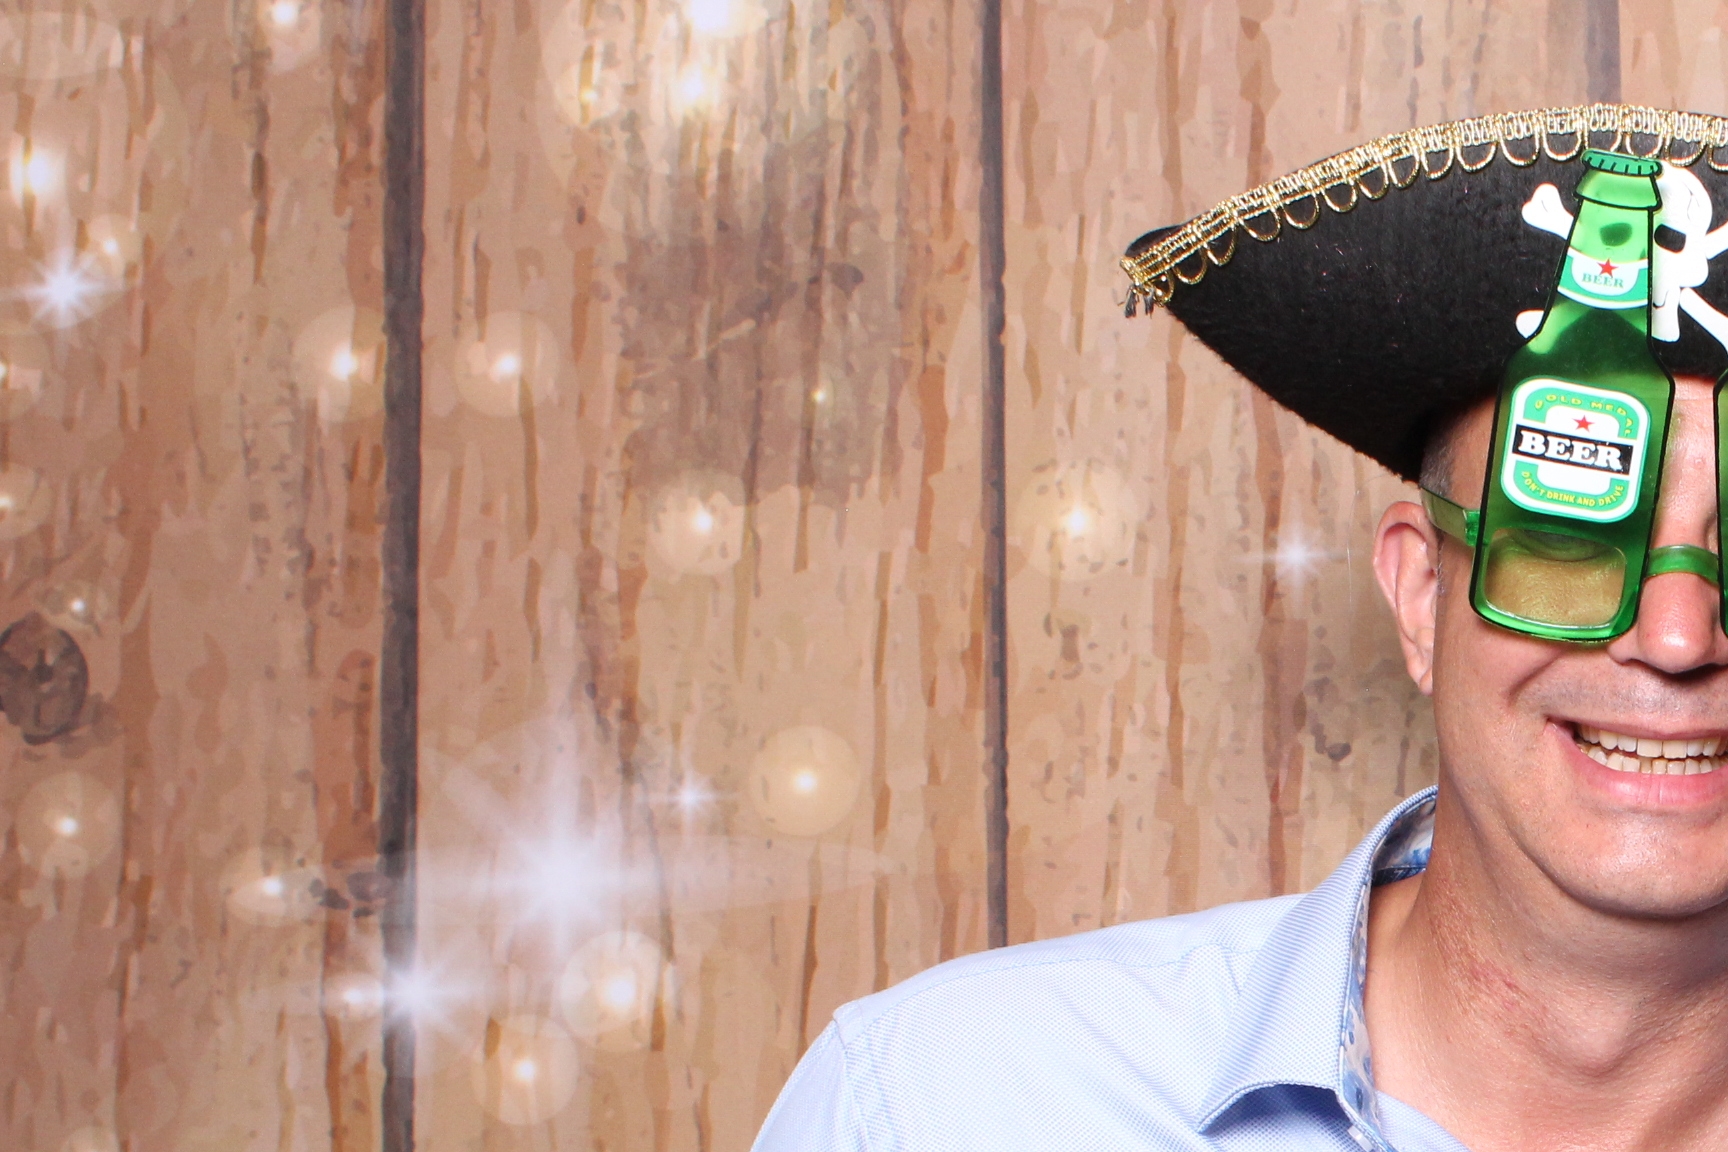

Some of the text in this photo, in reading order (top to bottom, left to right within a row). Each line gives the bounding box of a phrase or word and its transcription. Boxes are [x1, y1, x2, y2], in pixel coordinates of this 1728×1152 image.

[1581, 273, 1624, 289] BEER
[1518, 430, 1623, 472] BEER
[1521, 471, 1624, 507] DON'T DRINK AND DRIVE
